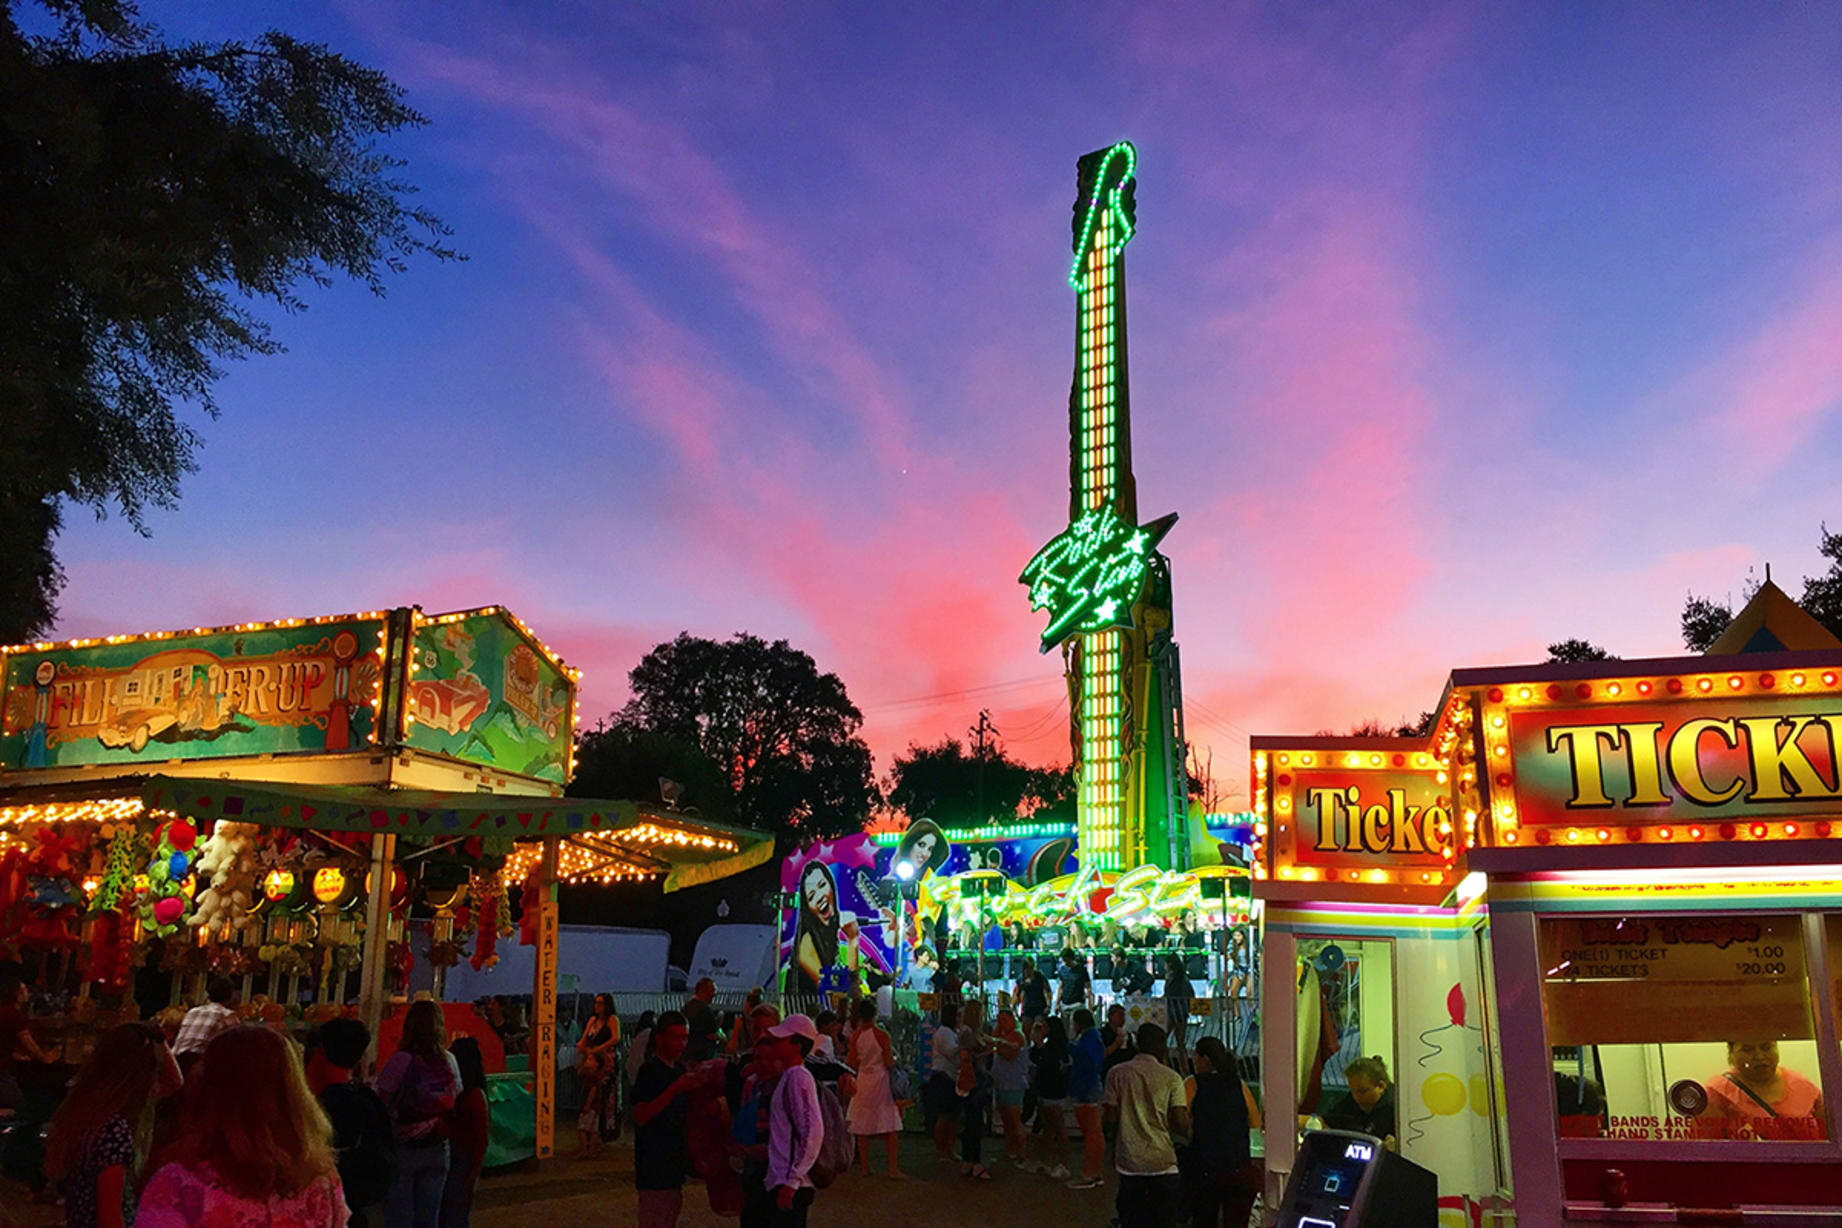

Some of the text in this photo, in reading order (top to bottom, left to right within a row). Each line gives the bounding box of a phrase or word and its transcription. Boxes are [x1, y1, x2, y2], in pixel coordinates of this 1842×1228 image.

[1545, 713, 1842, 810] TICK
[1306, 784, 1455, 855] Ticke
[1616, 948, 1669, 960] TICKET
[1588, 964, 1648, 976] TICKETS
[1610, 1115, 1659, 1128] BANDS
[1664, 1115, 1693, 1128] ARE
[1607, 1128, 1649, 1139] HAND
[1344, 1144, 1372, 1161] ATM
